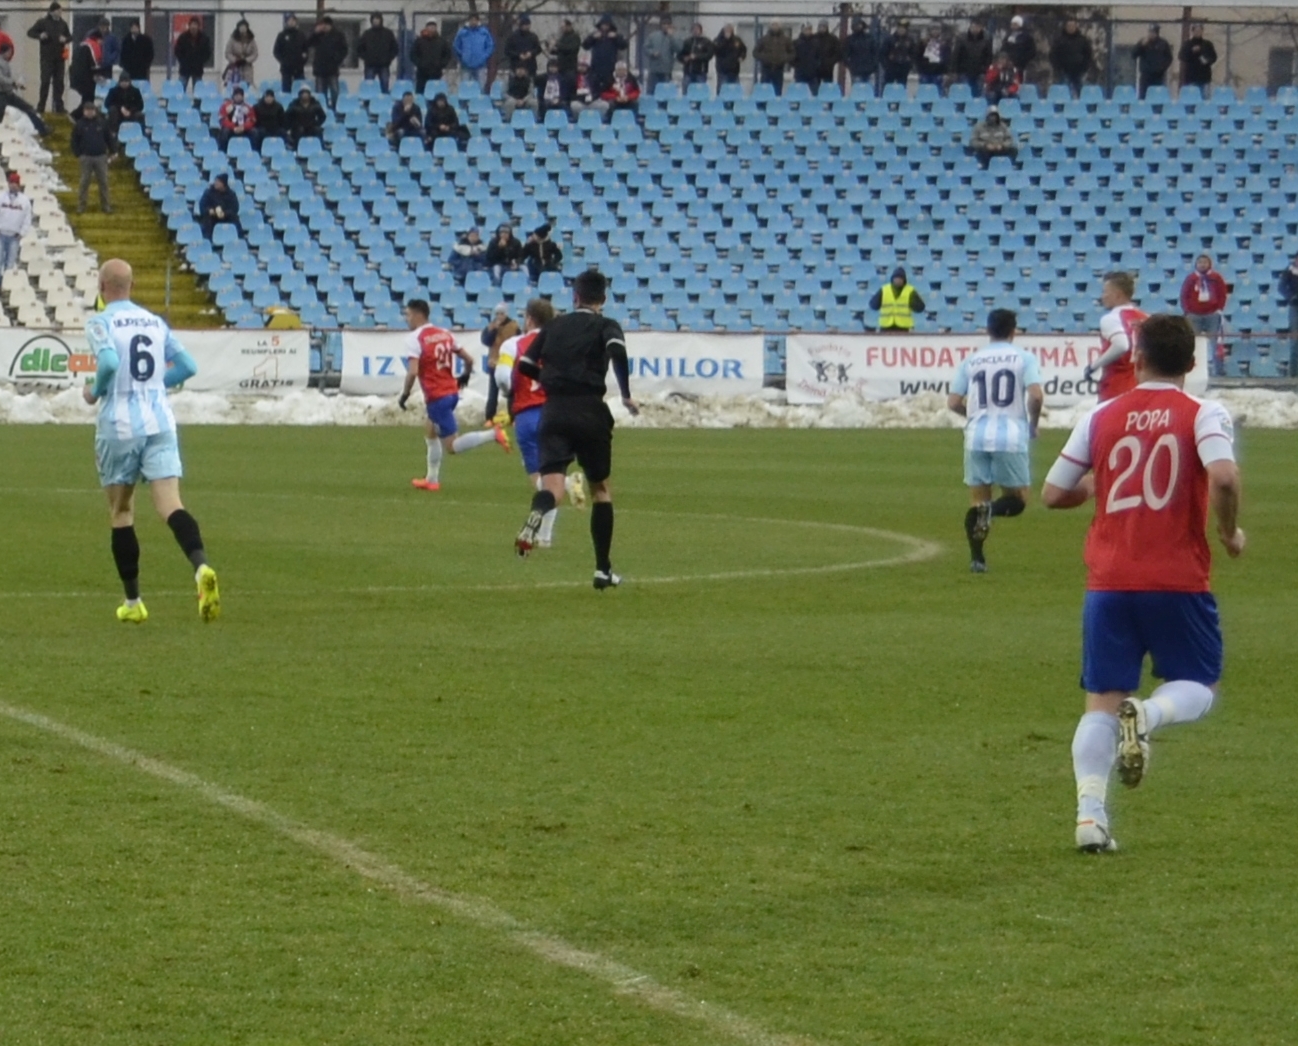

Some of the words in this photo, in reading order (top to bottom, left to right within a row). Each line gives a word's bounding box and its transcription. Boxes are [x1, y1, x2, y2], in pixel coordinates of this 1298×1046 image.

[271, 335, 280, 347] 5
[866, 347, 977, 367] FUNDAT
[129, 333, 156, 382] 6
[972, 368, 1016, 409] 10
[1125, 408, 1172, 432] POPA
[1106, 433, 1180, 514] 20
